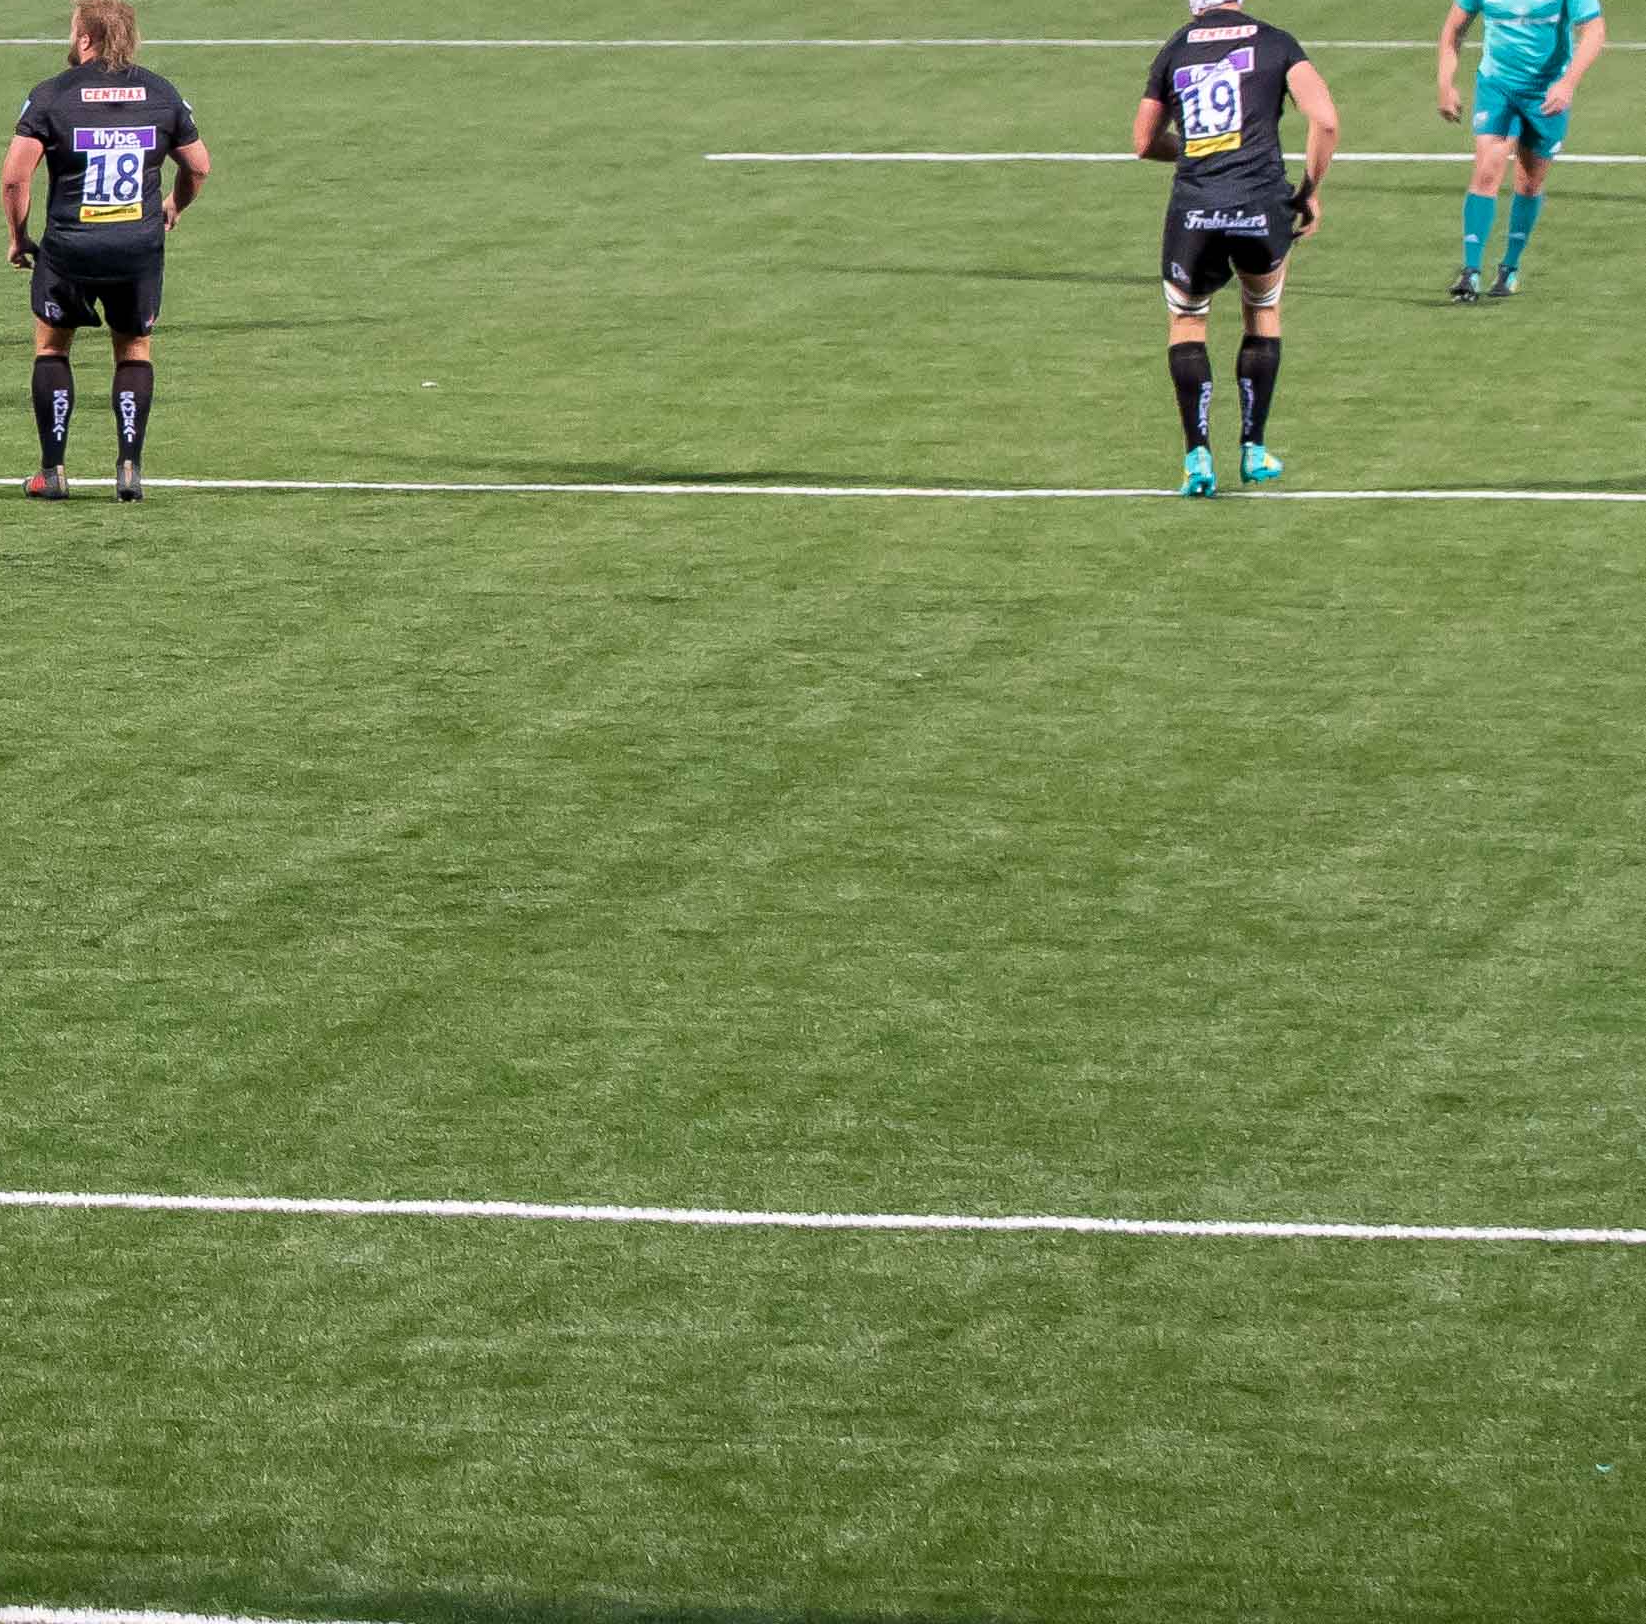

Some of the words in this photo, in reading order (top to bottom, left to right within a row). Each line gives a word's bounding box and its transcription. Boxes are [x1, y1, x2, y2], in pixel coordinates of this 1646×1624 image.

[83, 89, 144, 100] CENTRAX
[1179, 80, 1237, 135] 19
[86, 153, 140, 203] 18
